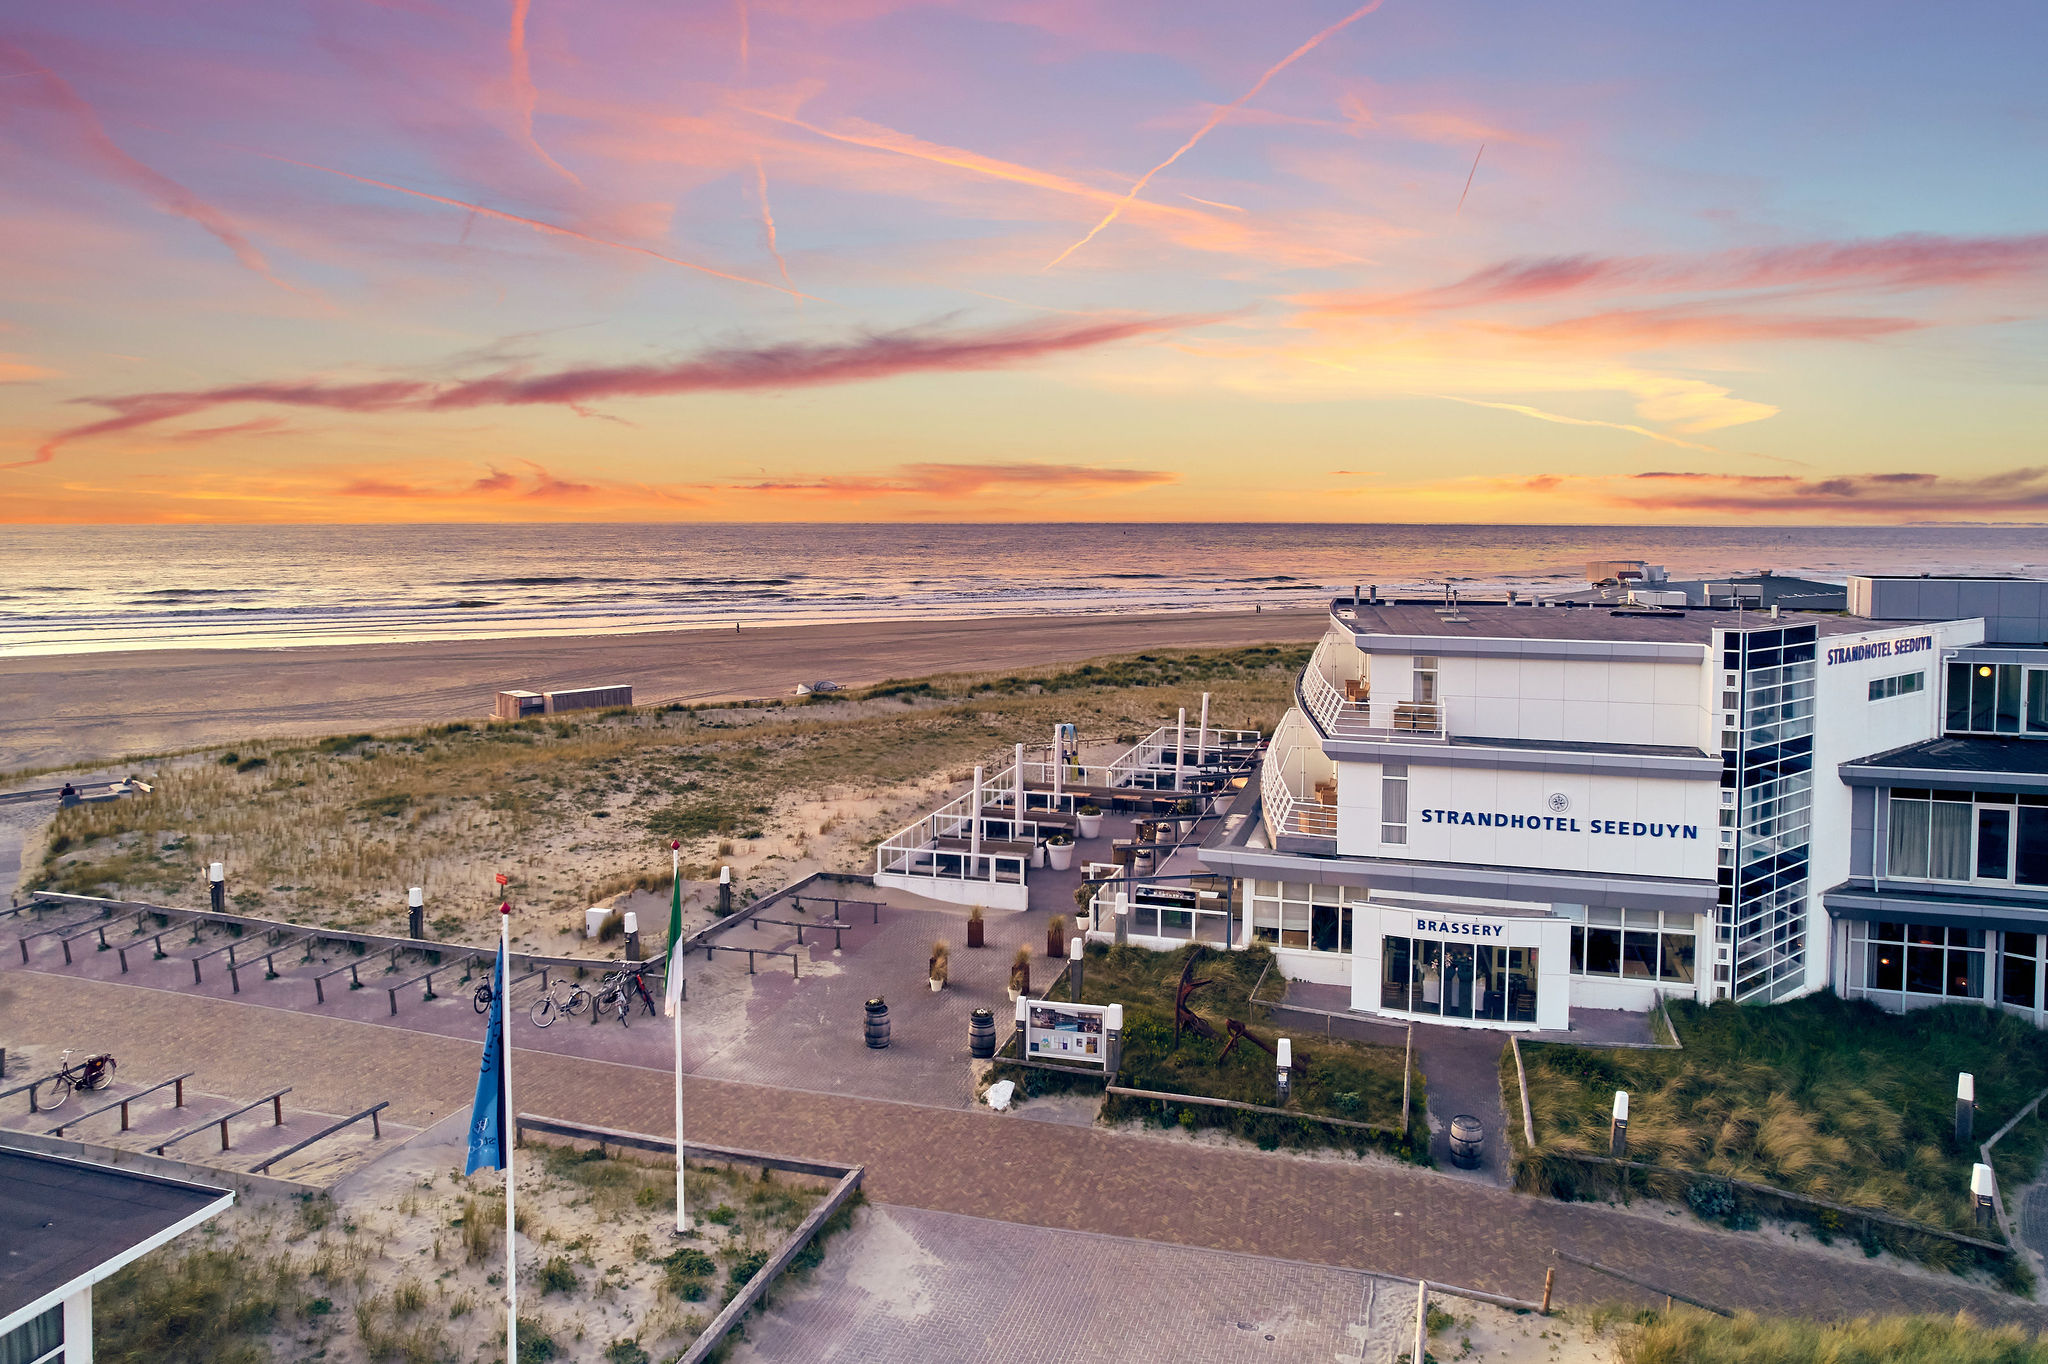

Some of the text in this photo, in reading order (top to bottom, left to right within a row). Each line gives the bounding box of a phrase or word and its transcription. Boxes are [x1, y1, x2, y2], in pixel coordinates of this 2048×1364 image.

[1828, 636, 1932, 665] STRANDHOTEL SEEDUYN
[1421, 808, 1698, 839] STRANDHOTEL SEEDUYN
[1417, 919, 1503, 937] BRASSERY
